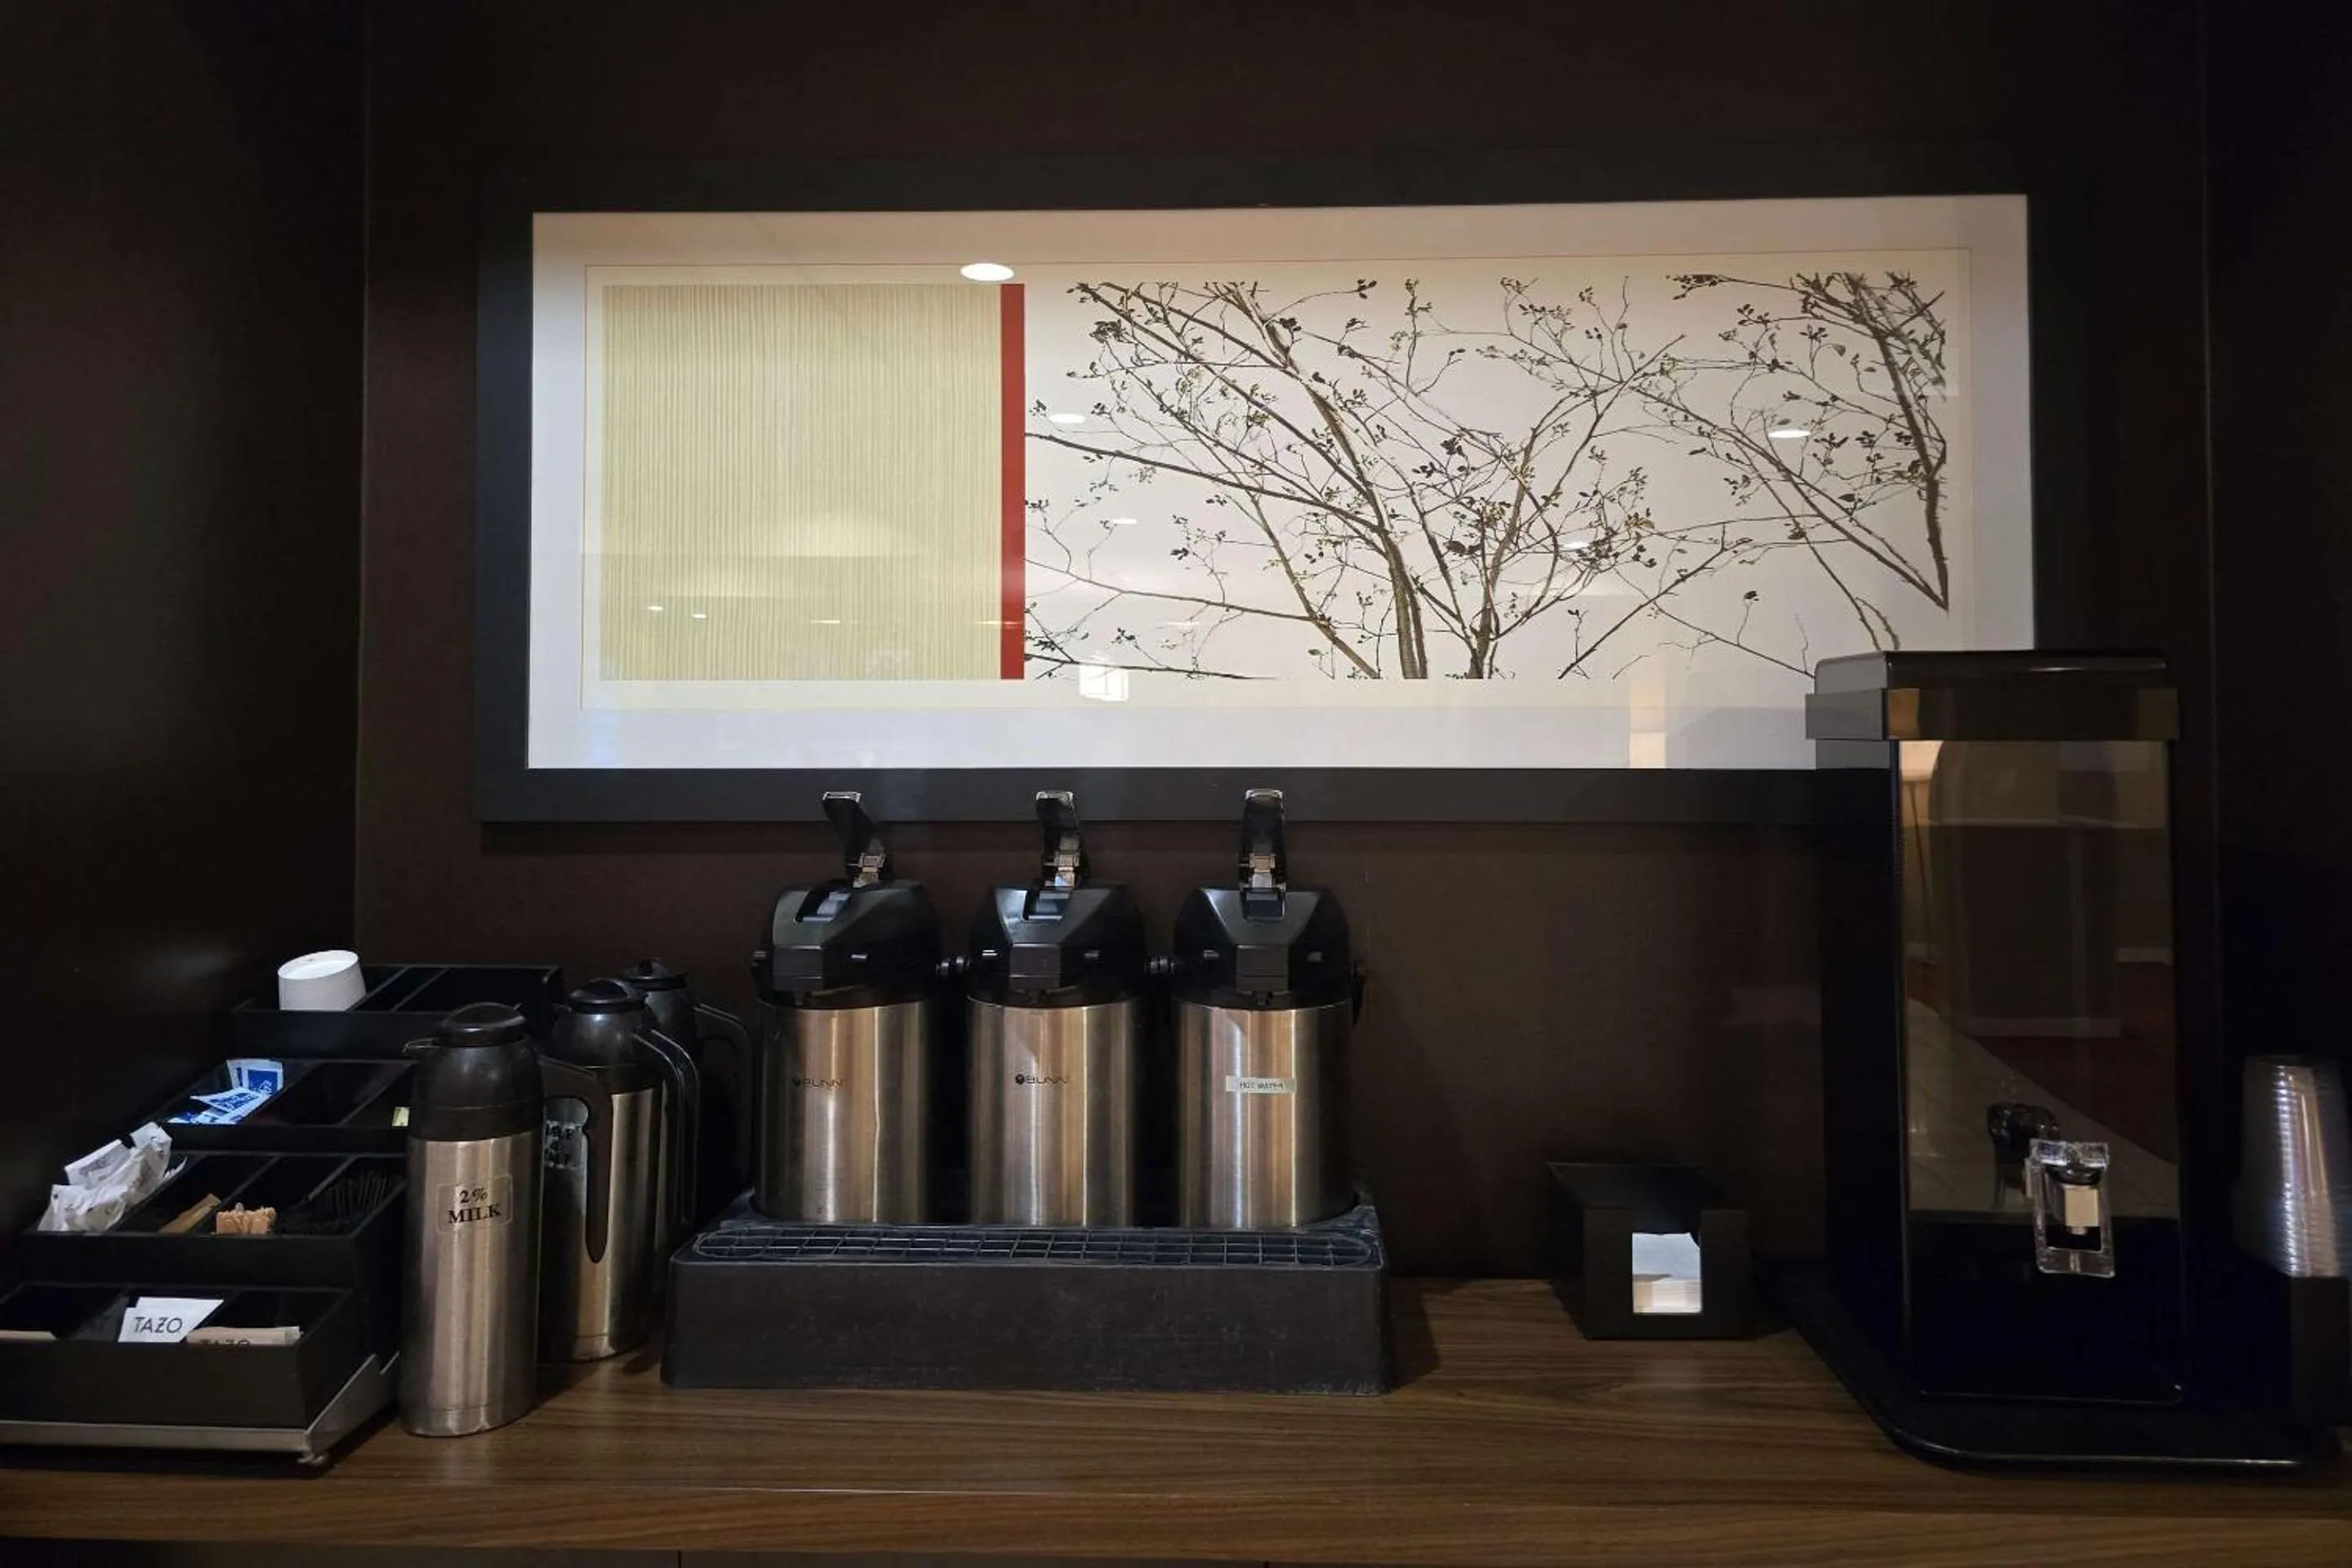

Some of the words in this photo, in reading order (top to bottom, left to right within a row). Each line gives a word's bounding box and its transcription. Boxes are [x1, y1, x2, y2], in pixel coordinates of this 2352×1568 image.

[459, 1187, 488, 1204] 2%
[446, 1203, 501, 1223] MILK
[133, 1316, 183, 1334] TAZO
